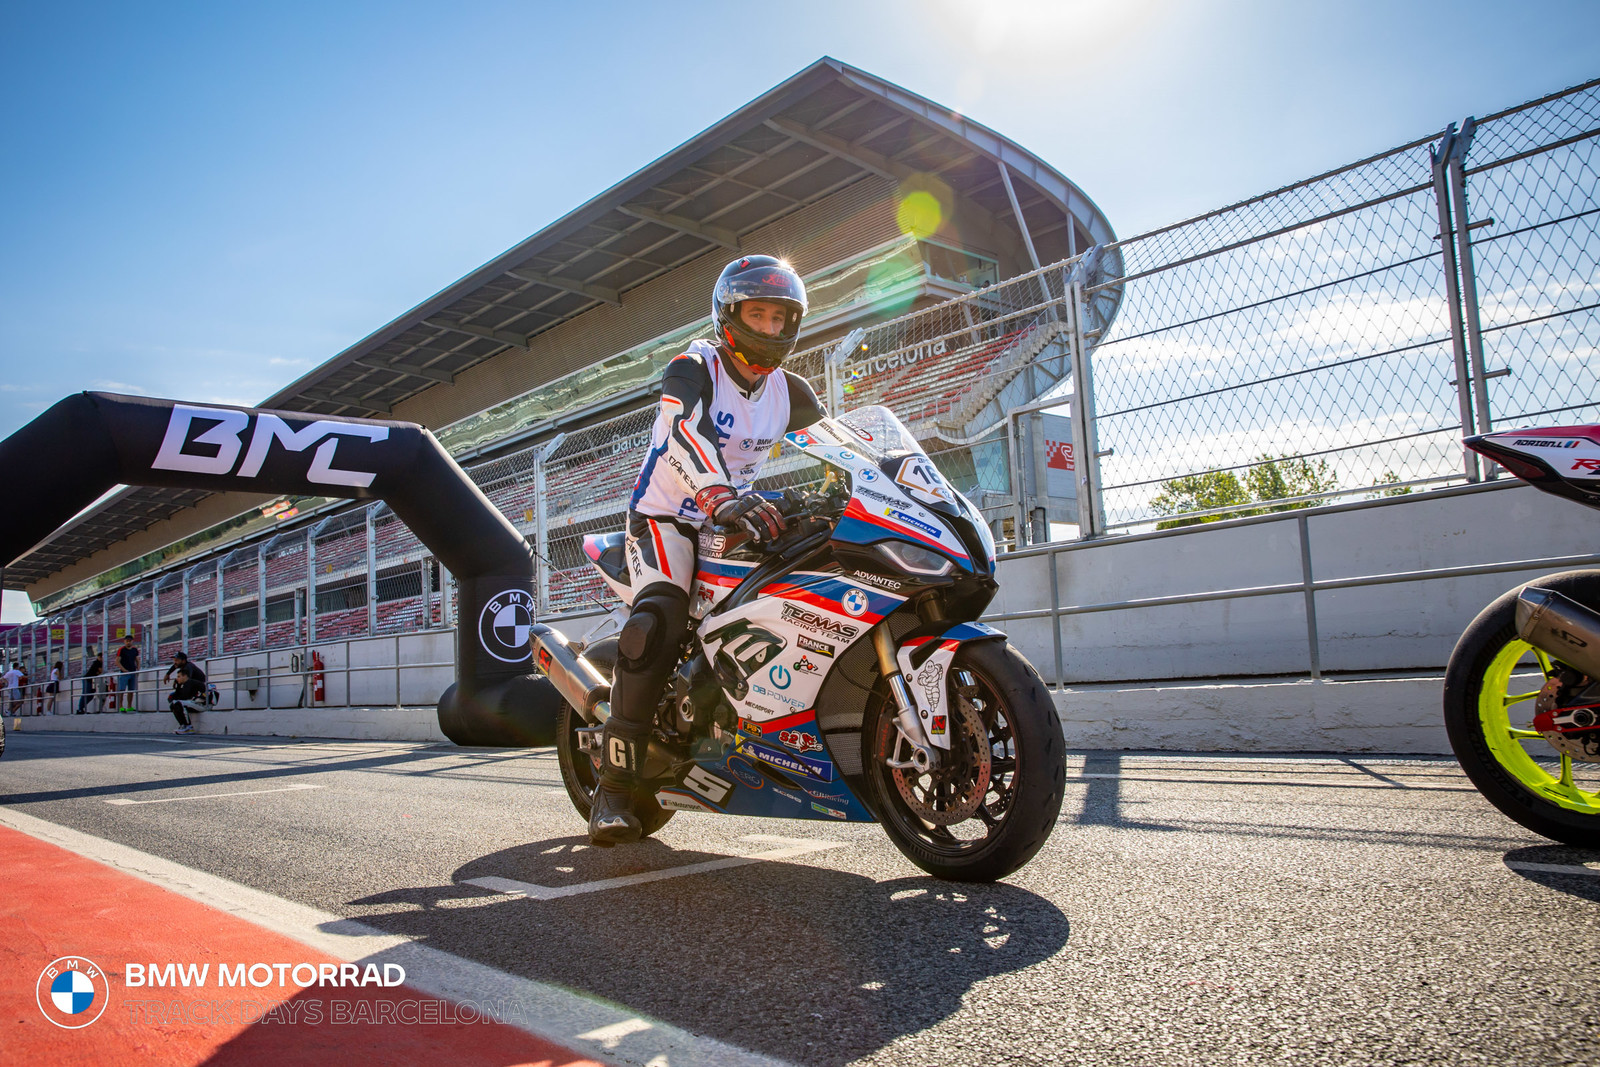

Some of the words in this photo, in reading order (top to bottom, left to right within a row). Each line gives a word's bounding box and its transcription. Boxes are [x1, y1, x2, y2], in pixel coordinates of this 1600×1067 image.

[842, 339, 947, 381] Barcelona
[150, 404, 390, 488] BMC
[613, 425, 652, 454] Barcel
[668, 455, 699, 493] DAINESE
[912, 465, 943, 485] 16
[900, 515, 937, 534] MICHELIN
[853, 569, 901, 590] ADVANTEC
[488, 593, 534, 614] BMW
[781, 615, 818, 634] RACING
[820, 631, 851, 644] TEAM
[782, 600, 860, 639] TECMAS
[798, 636, 830, 653] FRANCE
[744, 700, 775, 716] MECASPORT
[752, 684, 767, 696] DB
[767, 689, 806, 710] POWER
[609, 737, 627, 769] G
[758, 752, 823, 775] MICHELIN
